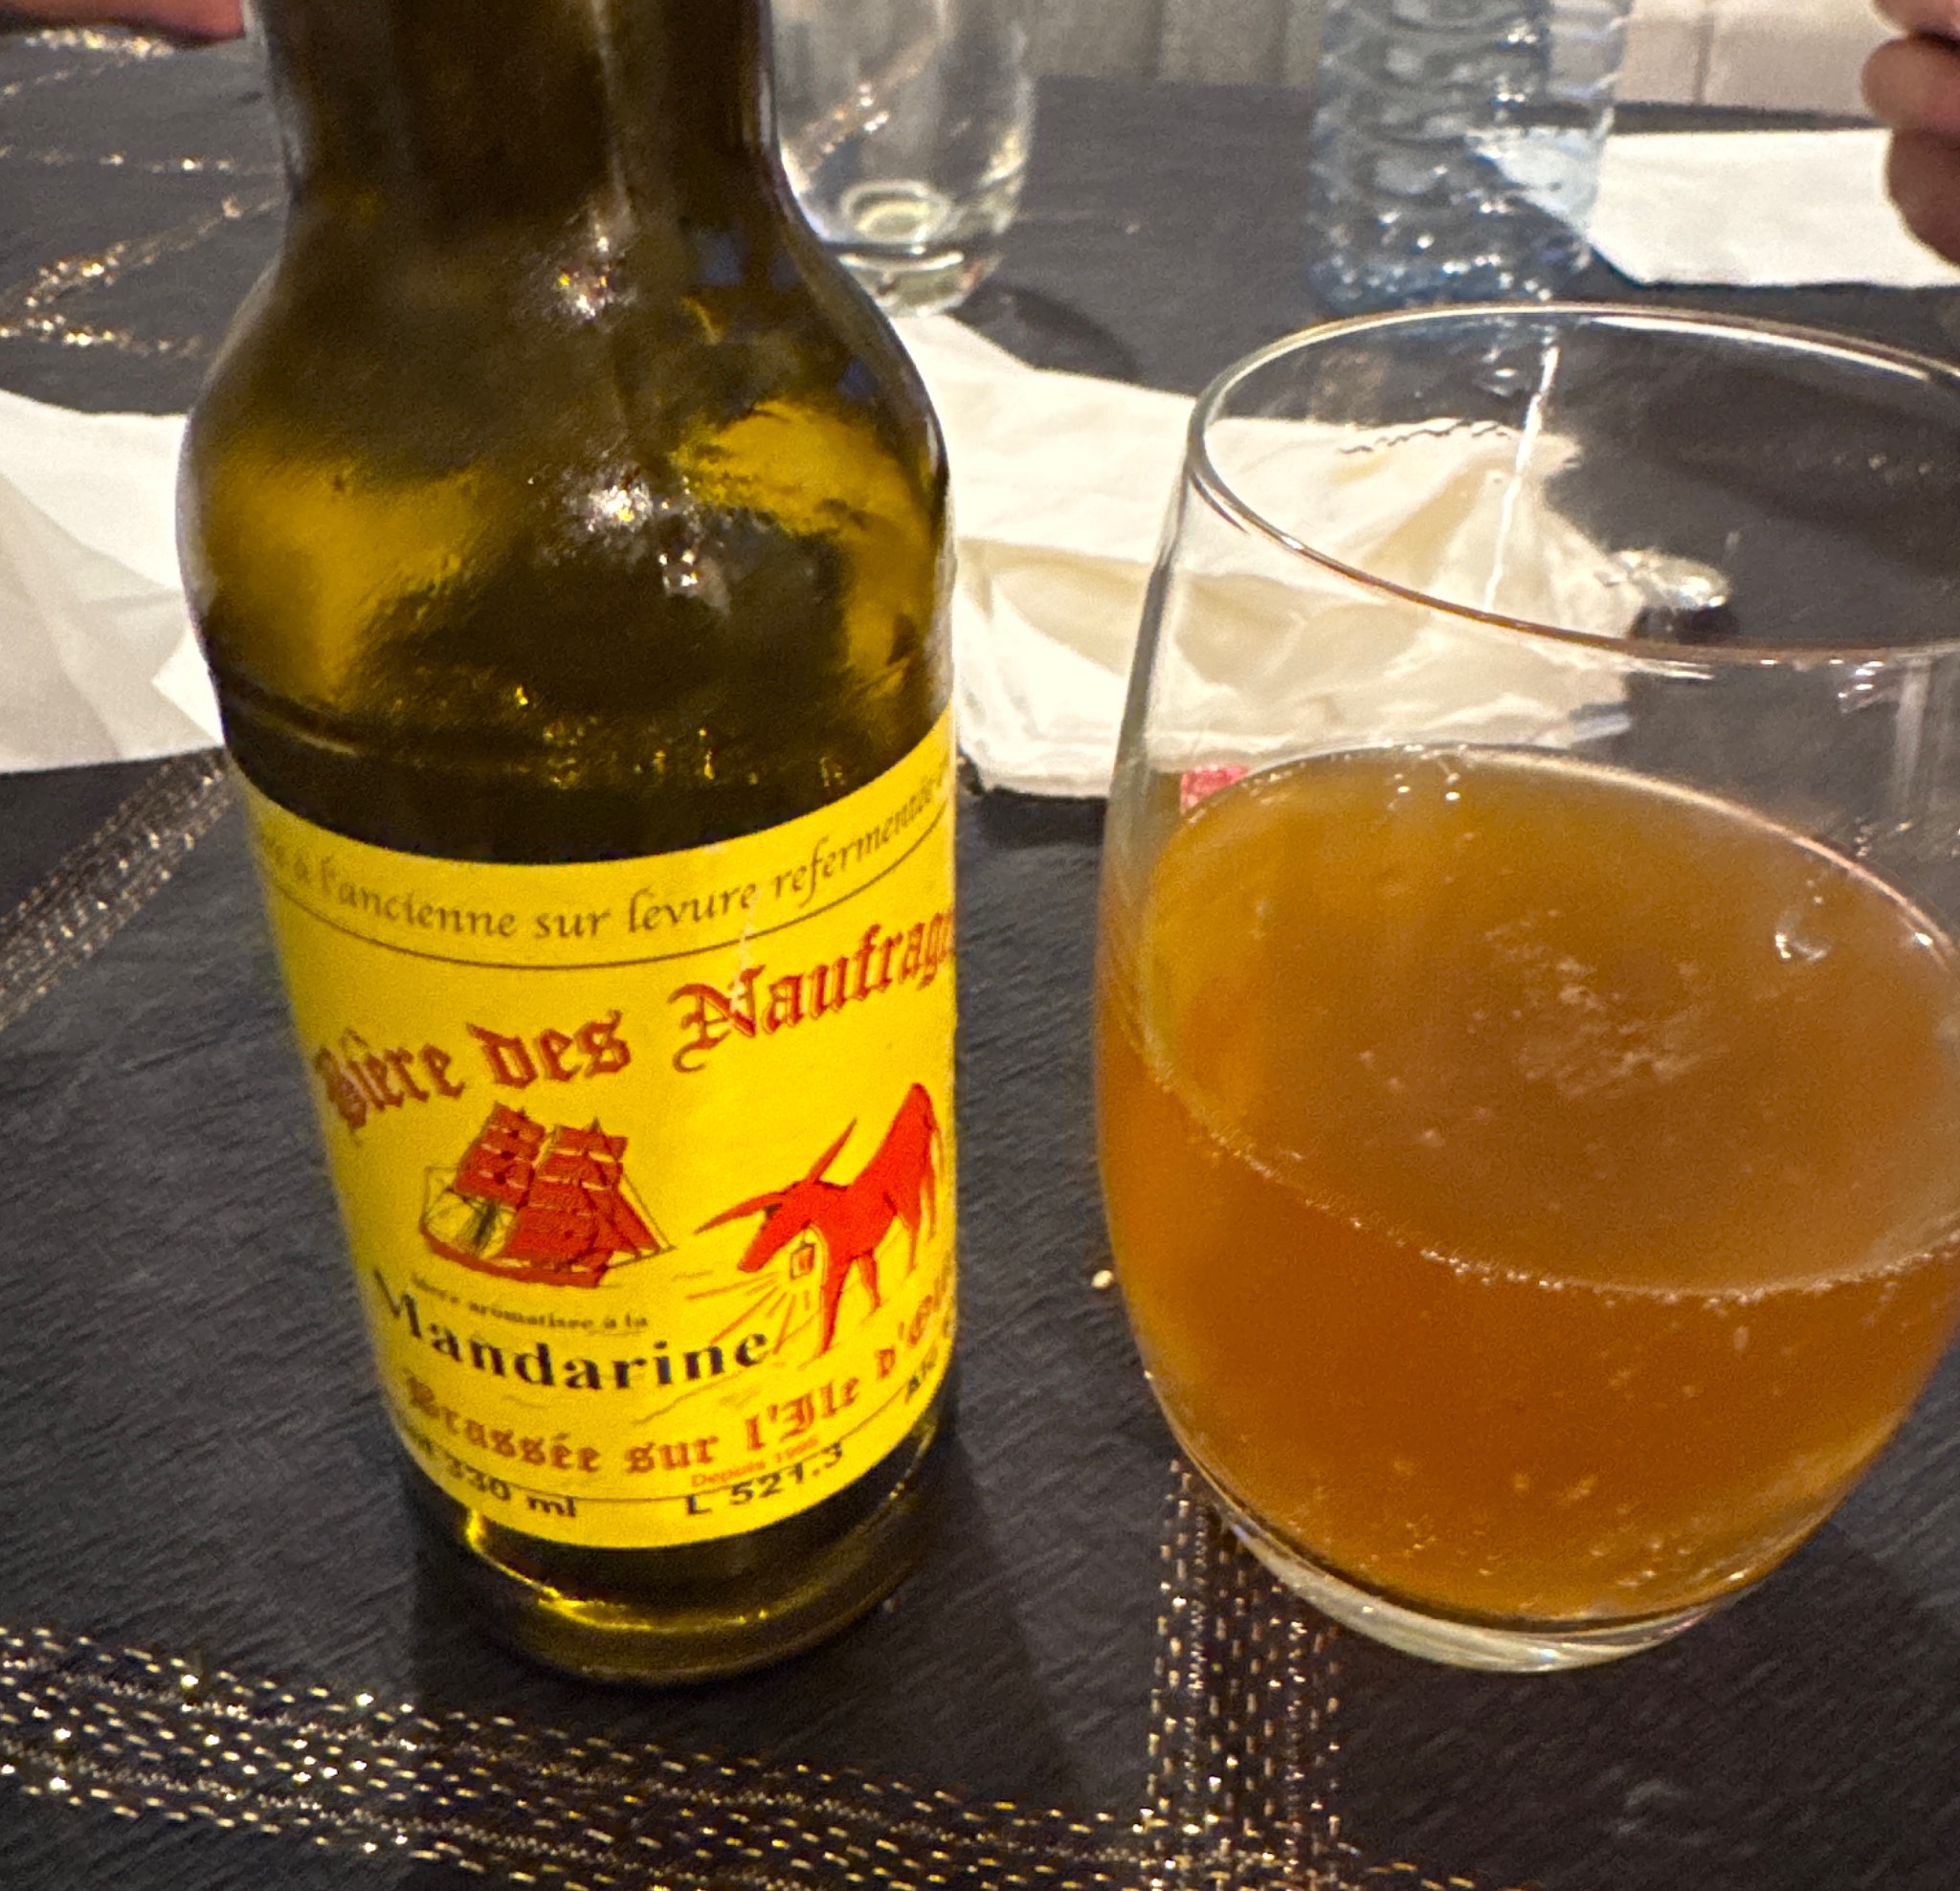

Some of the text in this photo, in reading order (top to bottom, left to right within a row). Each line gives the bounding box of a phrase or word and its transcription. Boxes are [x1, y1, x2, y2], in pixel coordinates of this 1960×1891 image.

[533, 909, 610, 940] sur
[627, 884, 757, 935] levure
[466, 1009, 631, 1089] des
[374, 1270, 768, 1390] Mandarine
[404, 1370, 602, 1473] Brassée
[626, 1435, 719, 1475] sur
[445, 1455, 511, 1502] 330
[527, 1495, 576, 1518] ml
[686, 1494, 713, 1516] L
[730, 1441, 843, 1505] 521.3
